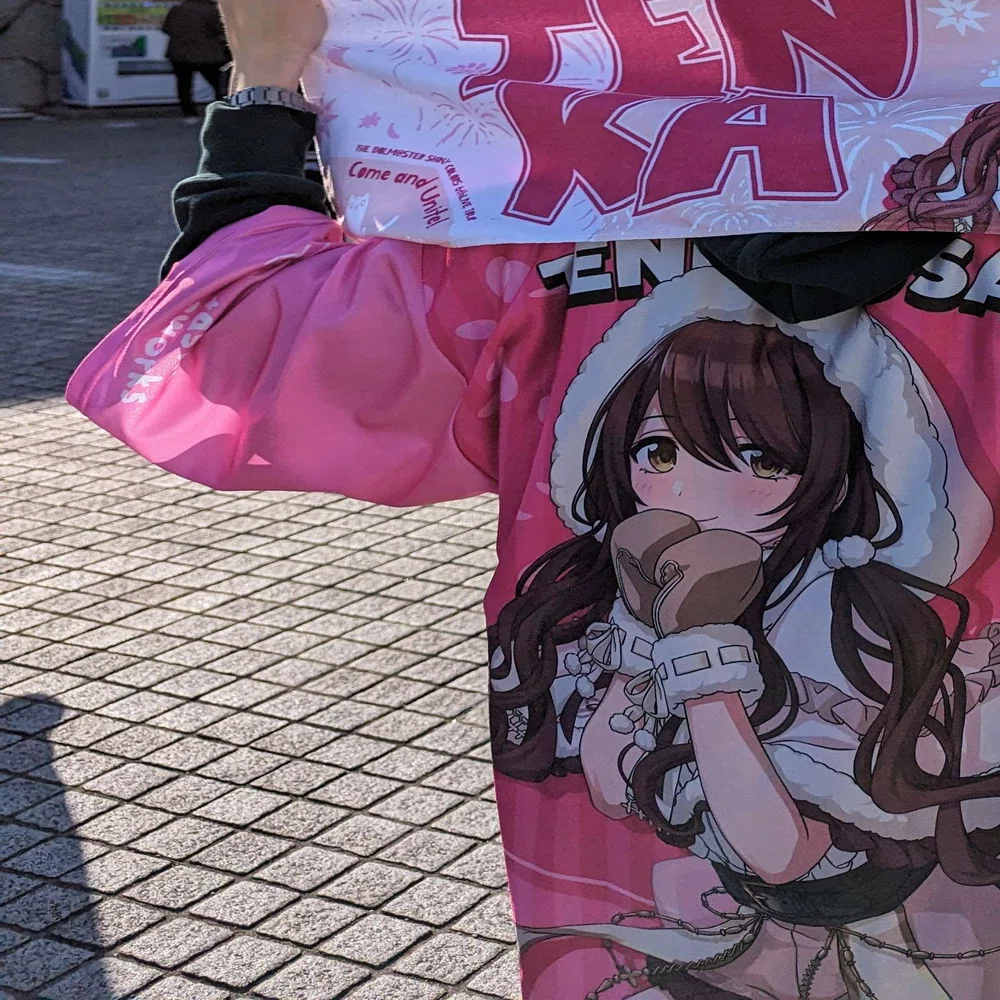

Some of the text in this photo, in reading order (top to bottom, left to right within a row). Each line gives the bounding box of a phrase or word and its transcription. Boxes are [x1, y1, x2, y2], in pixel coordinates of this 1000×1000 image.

[356, 144, 371, 153] THE
[424, 154, 452, 165] SHINY
[445, 164, 463, 186] COLORS
[496, 79, 848, 225] KA
[348, 161, 450, 229] Come and Unite!
